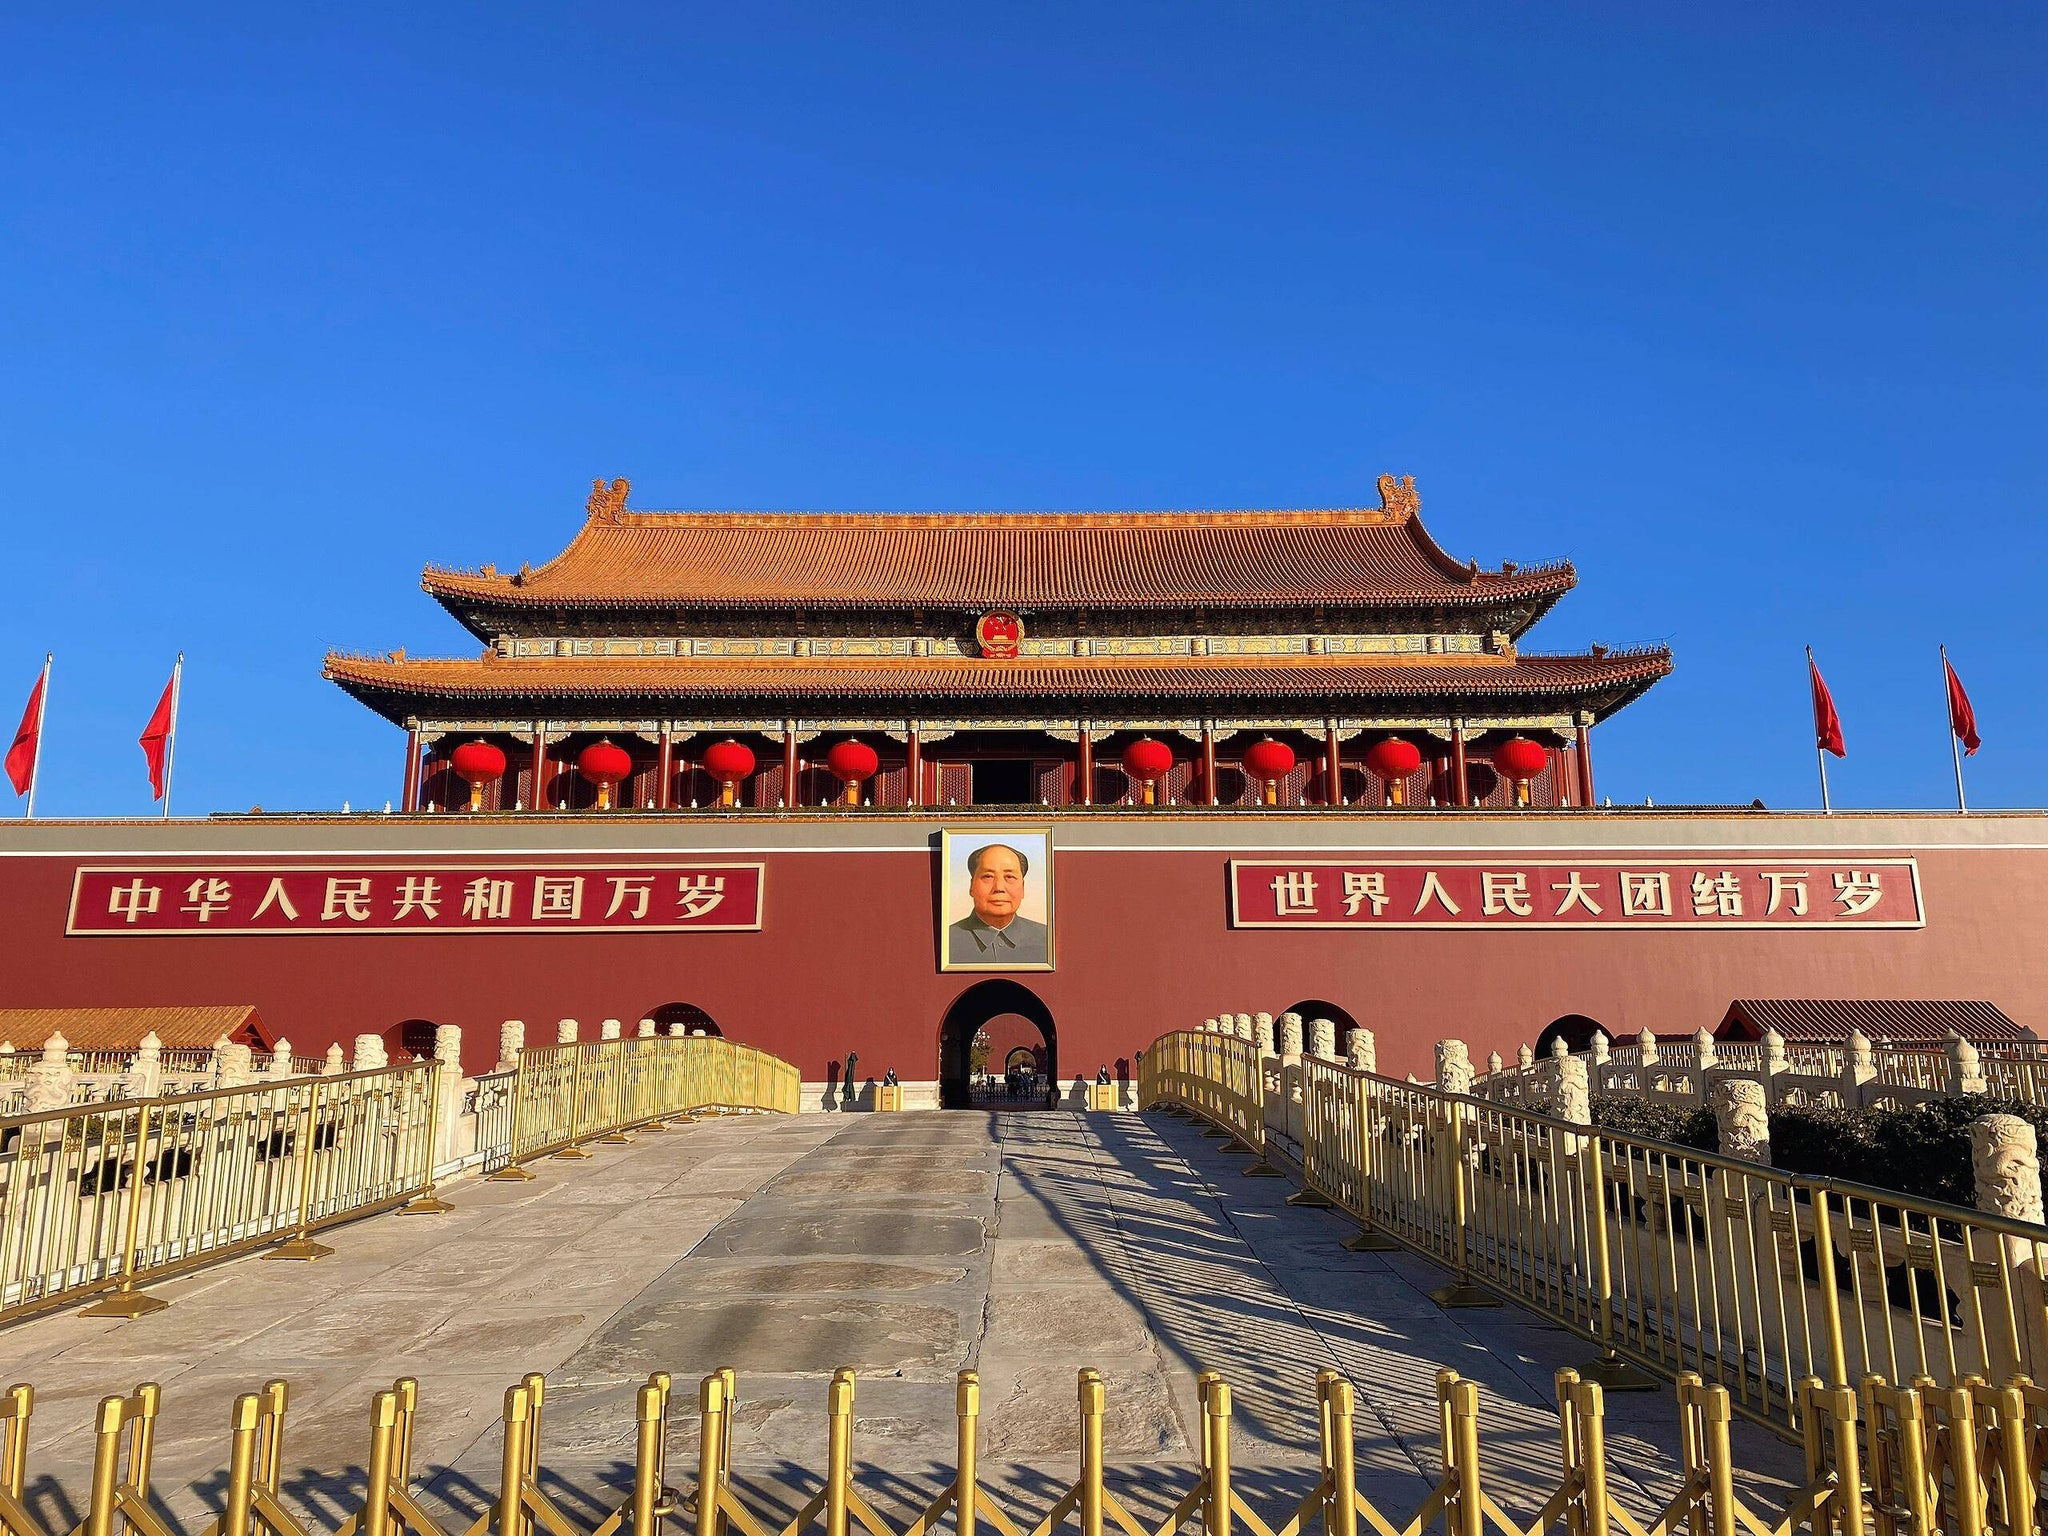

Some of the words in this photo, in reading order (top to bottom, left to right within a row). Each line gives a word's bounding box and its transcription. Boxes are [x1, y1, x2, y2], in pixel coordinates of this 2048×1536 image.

[107, 875, 727, 922] 中华人民共和国万岁
[1270, 870, 1884, 917] 世界人民大团结万岁
